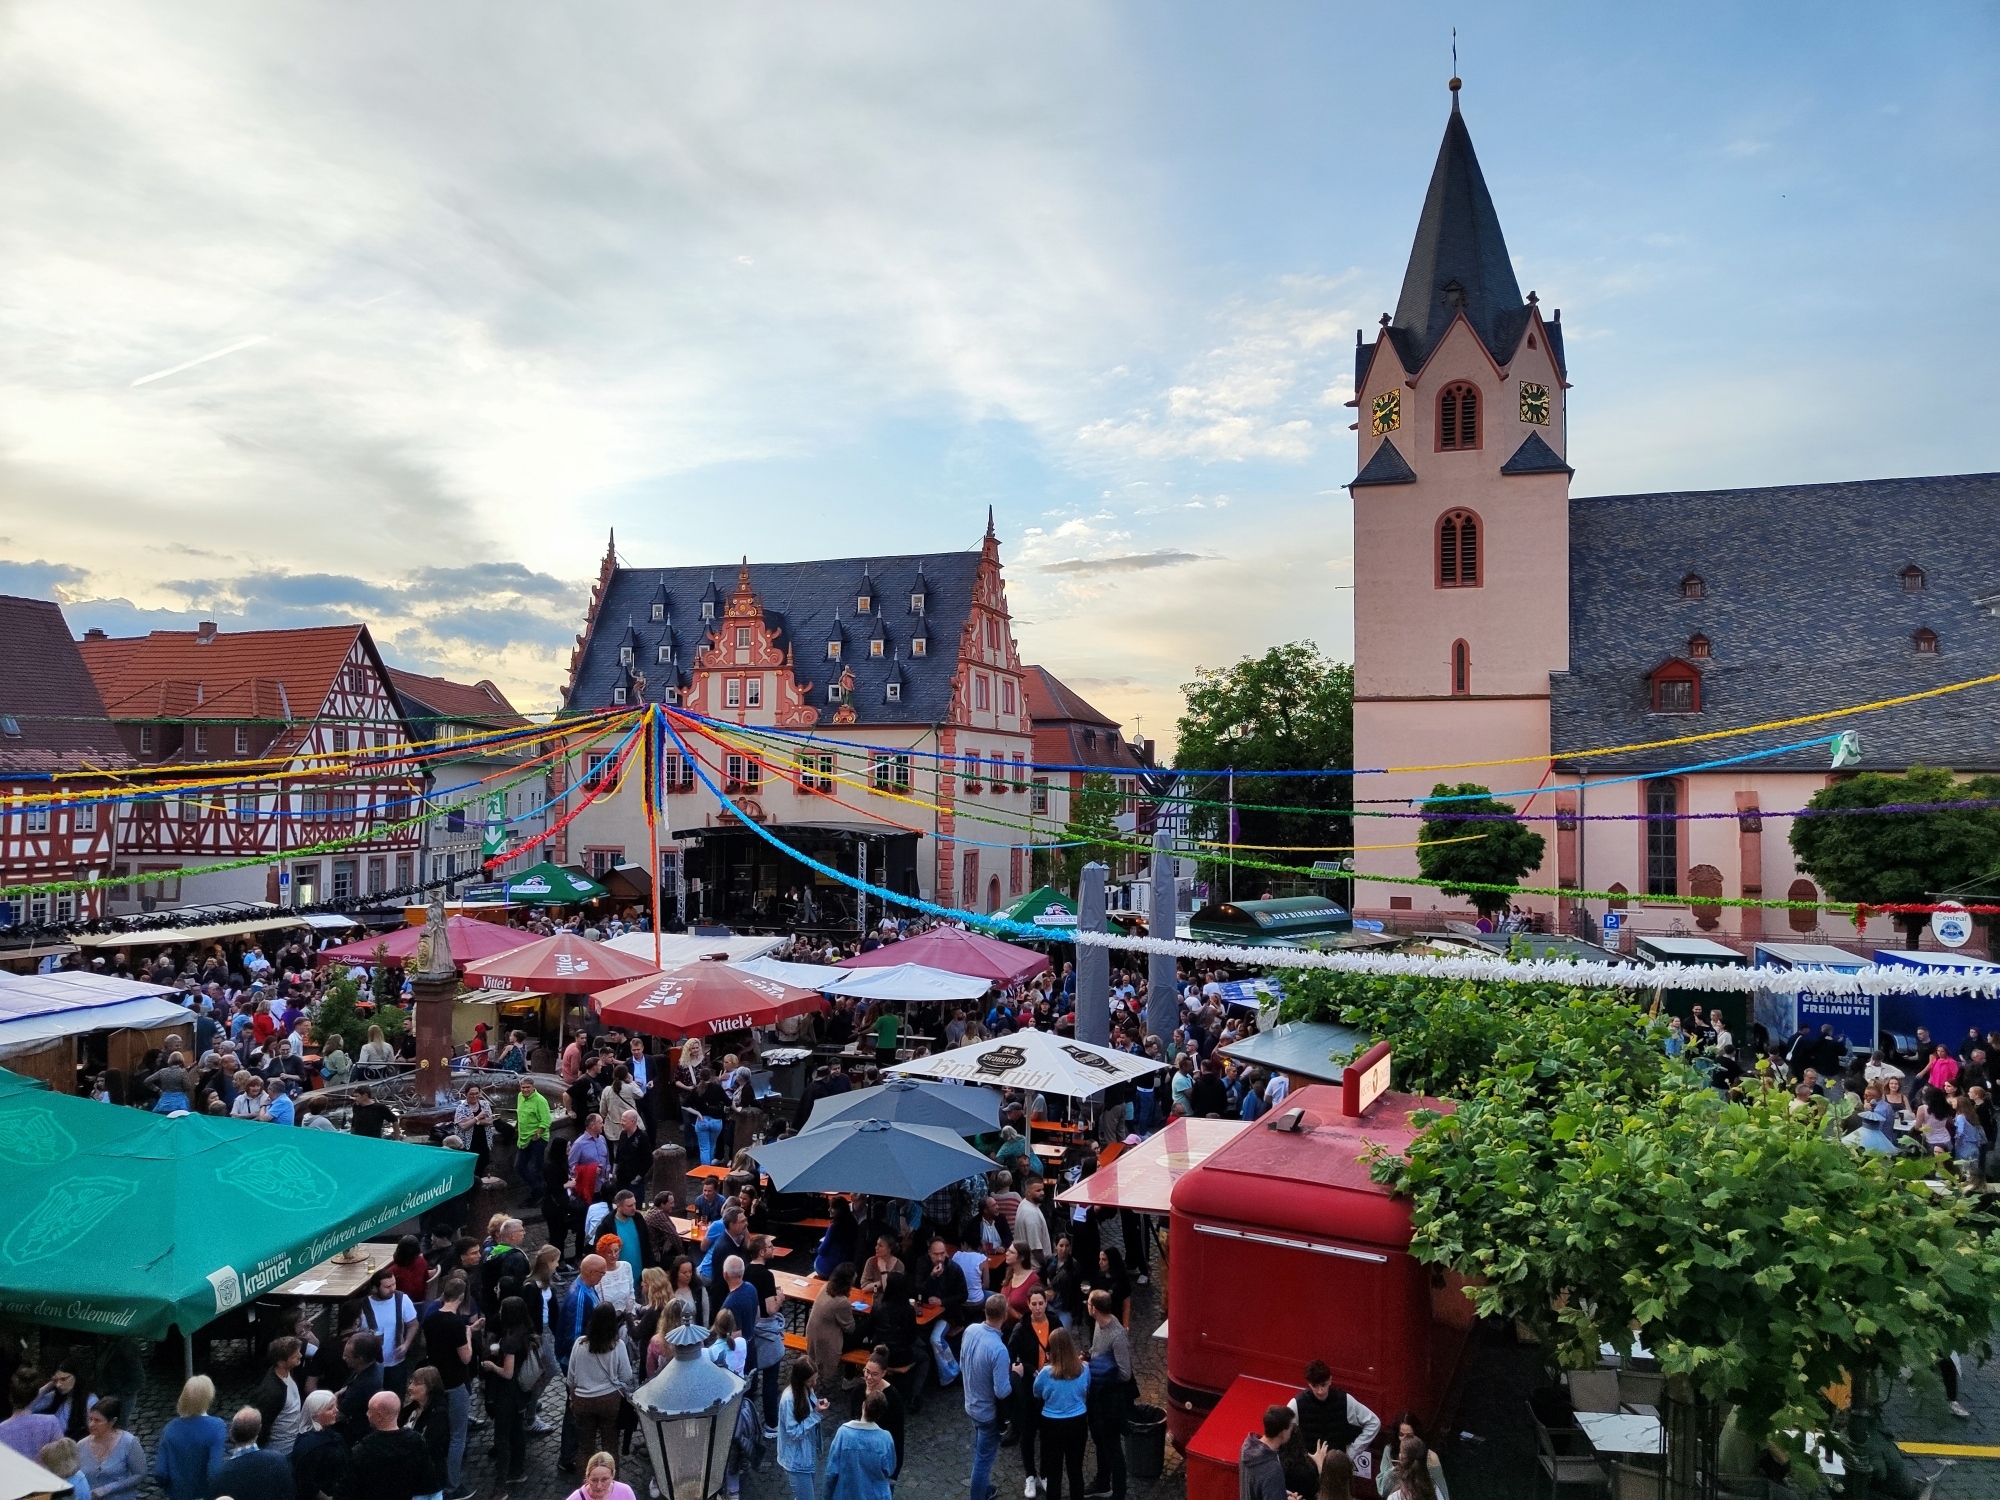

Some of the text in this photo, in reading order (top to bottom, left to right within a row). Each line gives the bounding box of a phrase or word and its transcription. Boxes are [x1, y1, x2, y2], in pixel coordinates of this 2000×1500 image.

[1272, 912, 1289, 920] DIE
[1607, 916, 1616, 927] P
[1936, 914, 1968, 922] Central
[554, 954, 573, 976] Vittel
[482, 976, 506, 990] Vittel
[636, 981, 677, 1010] Vittel
[1802, 1004, 1870, 1016] FREIMUTH
[708, 1015, 744, 1034] Vittel
[298, 1175, 453, 1265] Apfelwein aus dem Odenwald
[264, 1252, 287, 1267] KELTEREI
[242, 1257, 292, 1297] krämer
[7, 1300, 137, 1327] aus dem Odenwald
